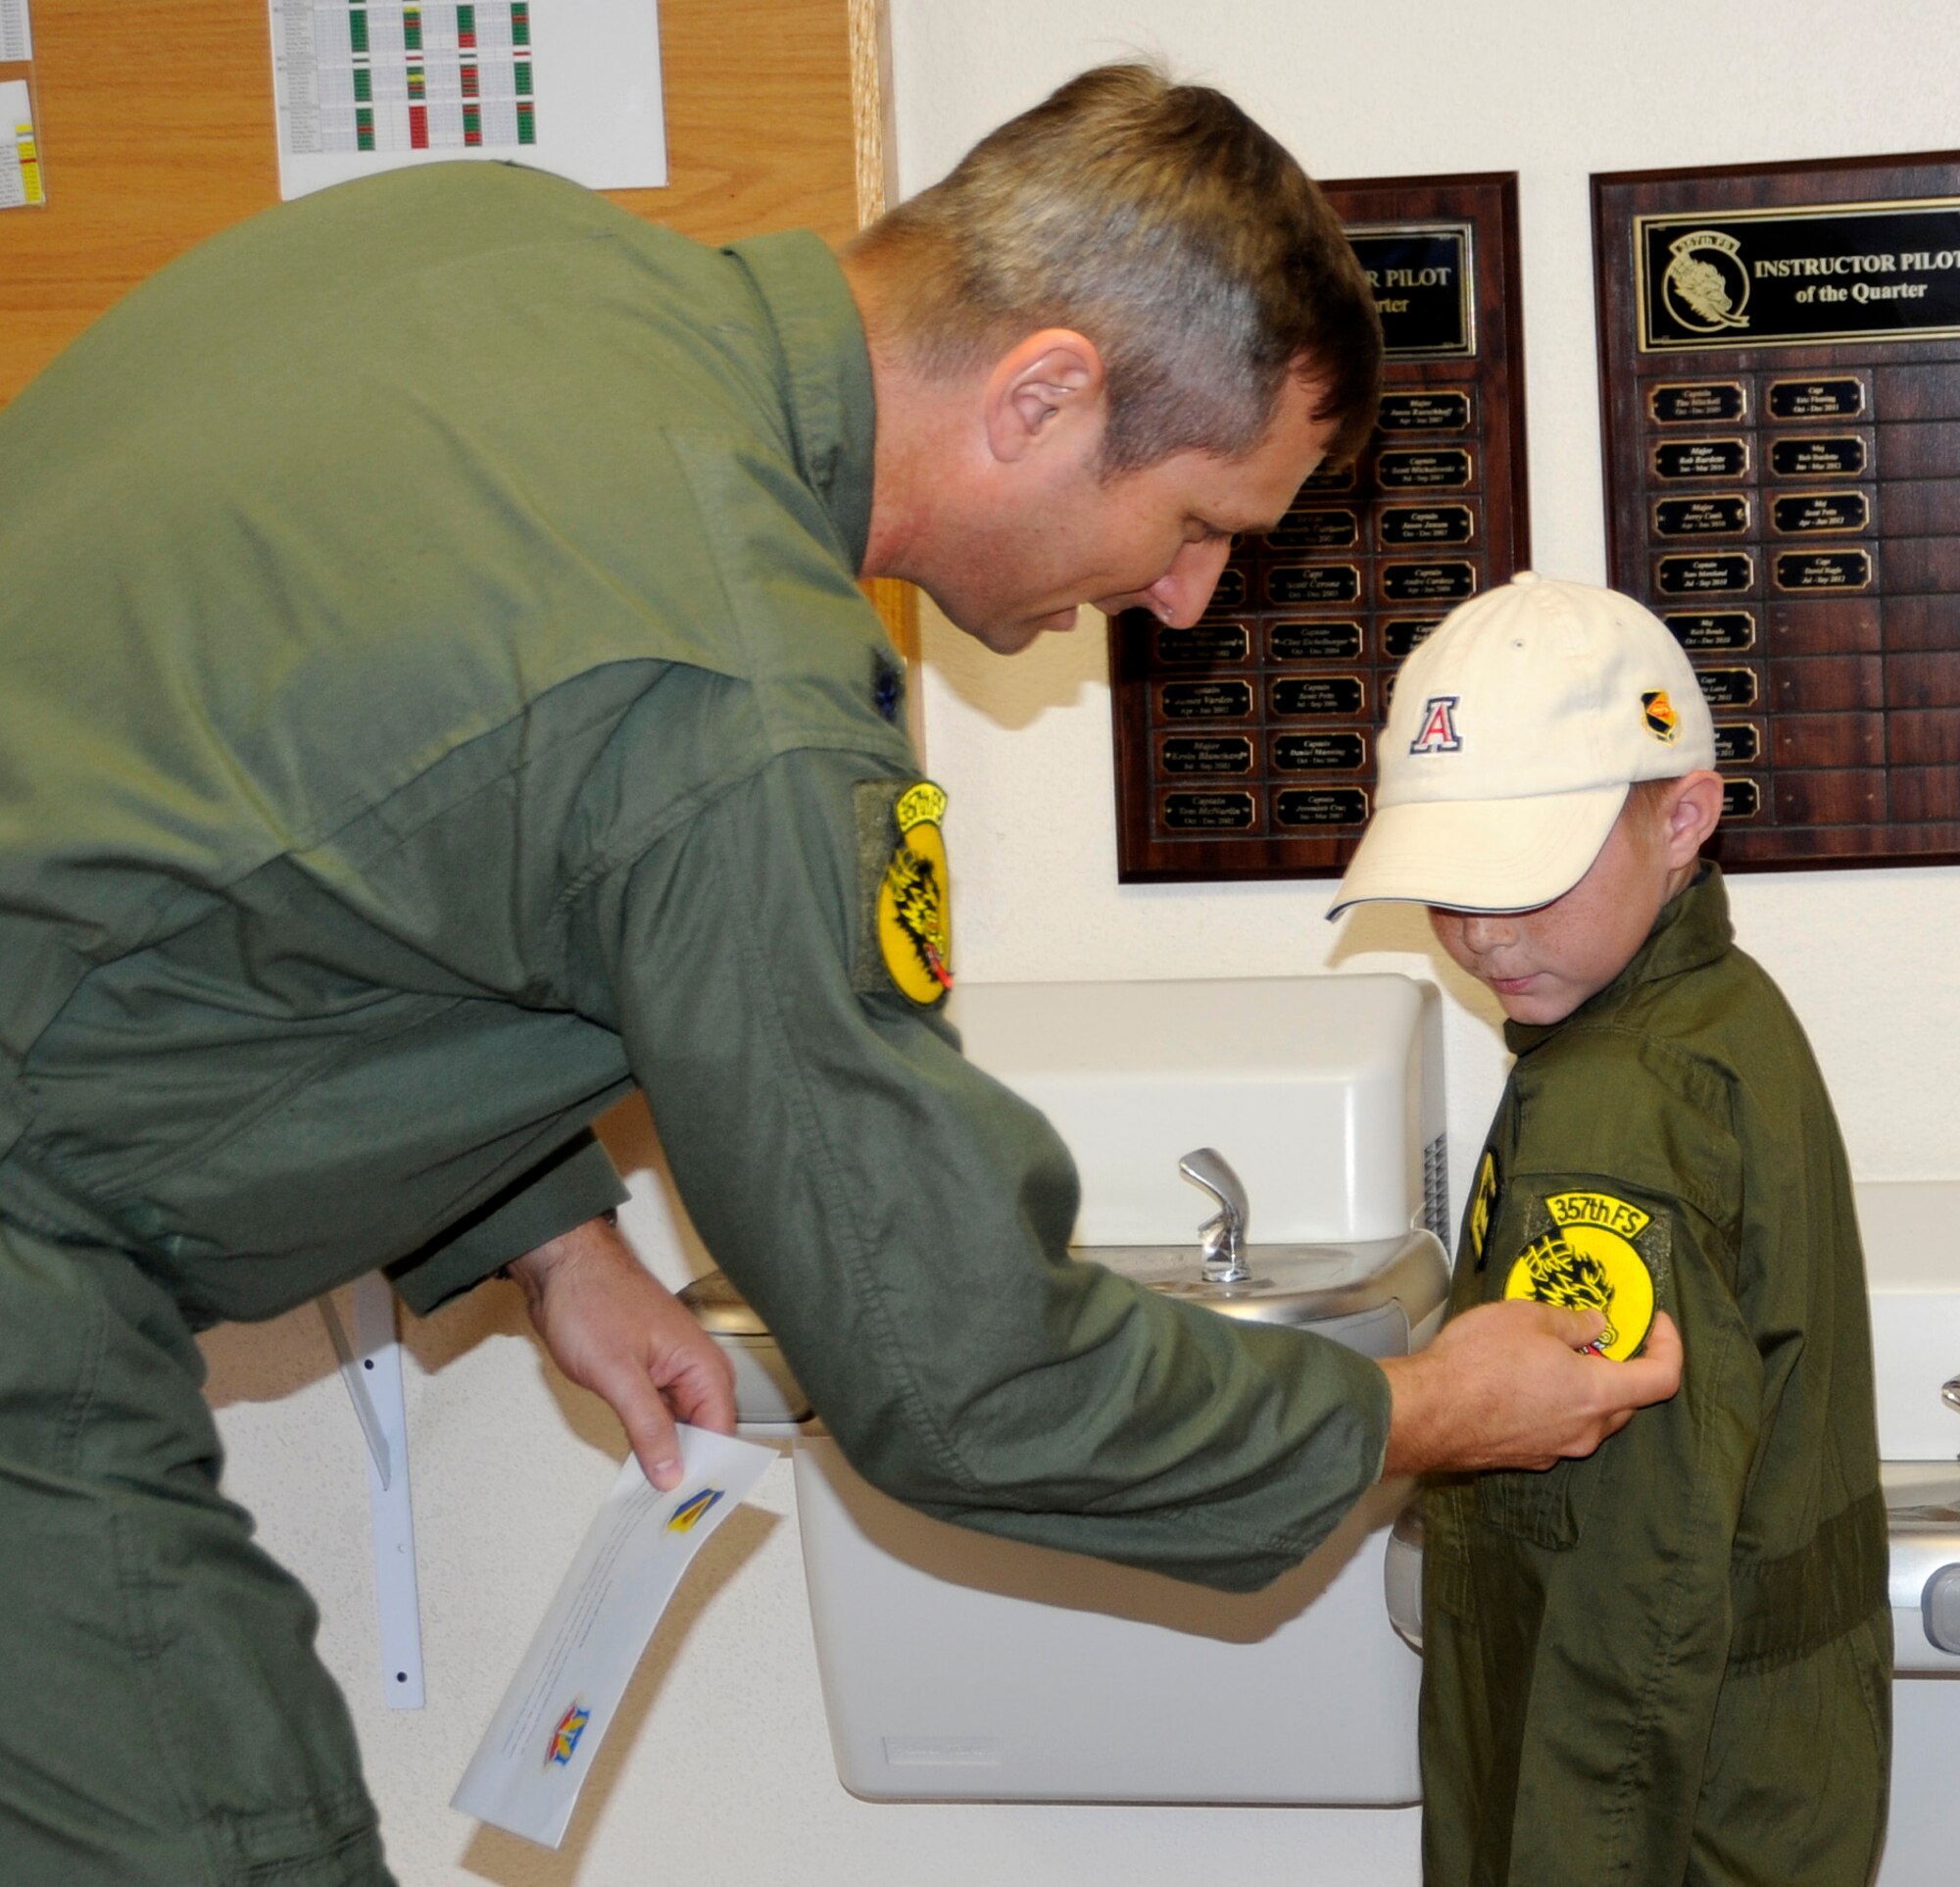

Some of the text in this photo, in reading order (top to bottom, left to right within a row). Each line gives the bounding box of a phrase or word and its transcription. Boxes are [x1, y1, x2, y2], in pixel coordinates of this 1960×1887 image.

[1754, 253, 1896, 278] INSTRUCTOR
[1385, 268, 1451, 287] PILOT
[1795, 282, 1928, 304] of the Quarter
[1682, 389, 1712, 398] Captain
[1807, 386, 1824, 395] Capt
[1690, 447, 1714, 456] Major
[1811, 444, 1825, 453] Maj
[1691, 503, 1715, 512] Major
[1410, 513, 1439, 521] Captain
[1692, 561, 1718, 570] Captain
[1302, 570, 1323, 579] Capt
[1409, 695, 1463, 756] A
[1194, 742, 1220, 751] Major
[1303, 740, 1331, 749] Captain
[1192, 796, 1226, 806] Captain
[1307, 796, 1335, 805] Captain
[1553, 1196, 1642, 1234] 357th FS
